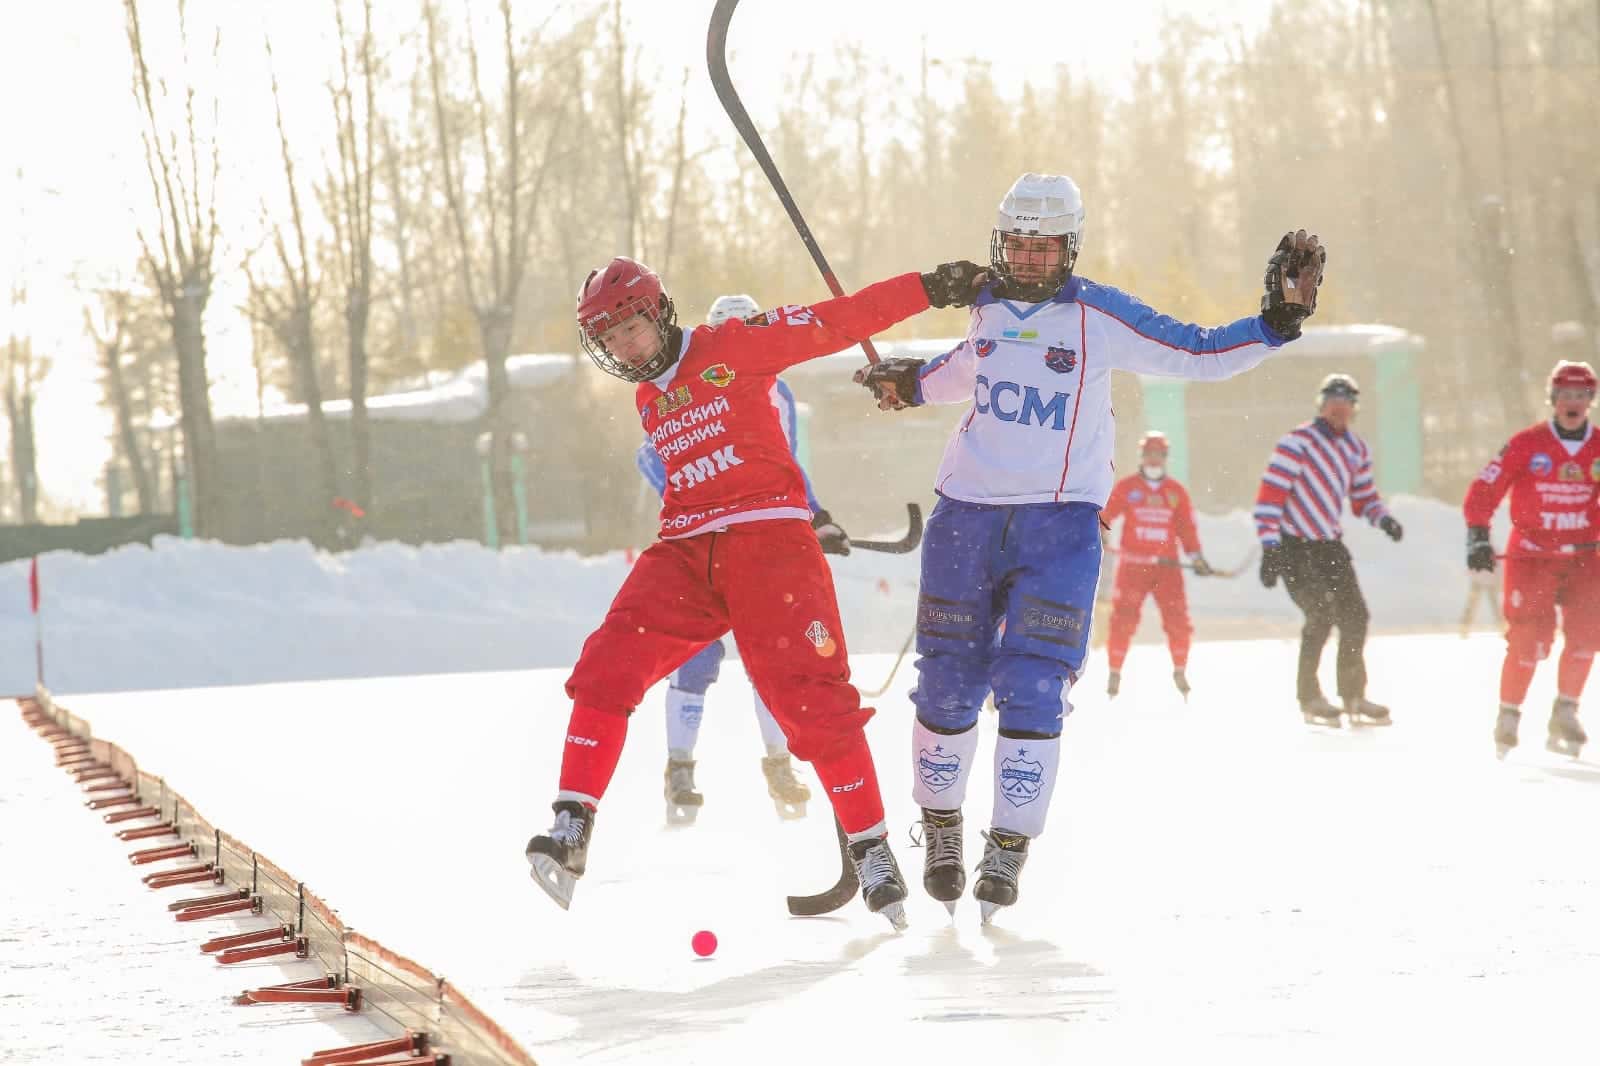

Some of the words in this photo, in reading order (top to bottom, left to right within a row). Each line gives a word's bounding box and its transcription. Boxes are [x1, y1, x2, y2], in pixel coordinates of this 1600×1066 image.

[652, 395, 730, 446] РАЛЬСКИЙ
[670, 444, 744, 492] ТМК
[567, 734, 599, 747] CCM
[832, 778, 864, 793] CCM
